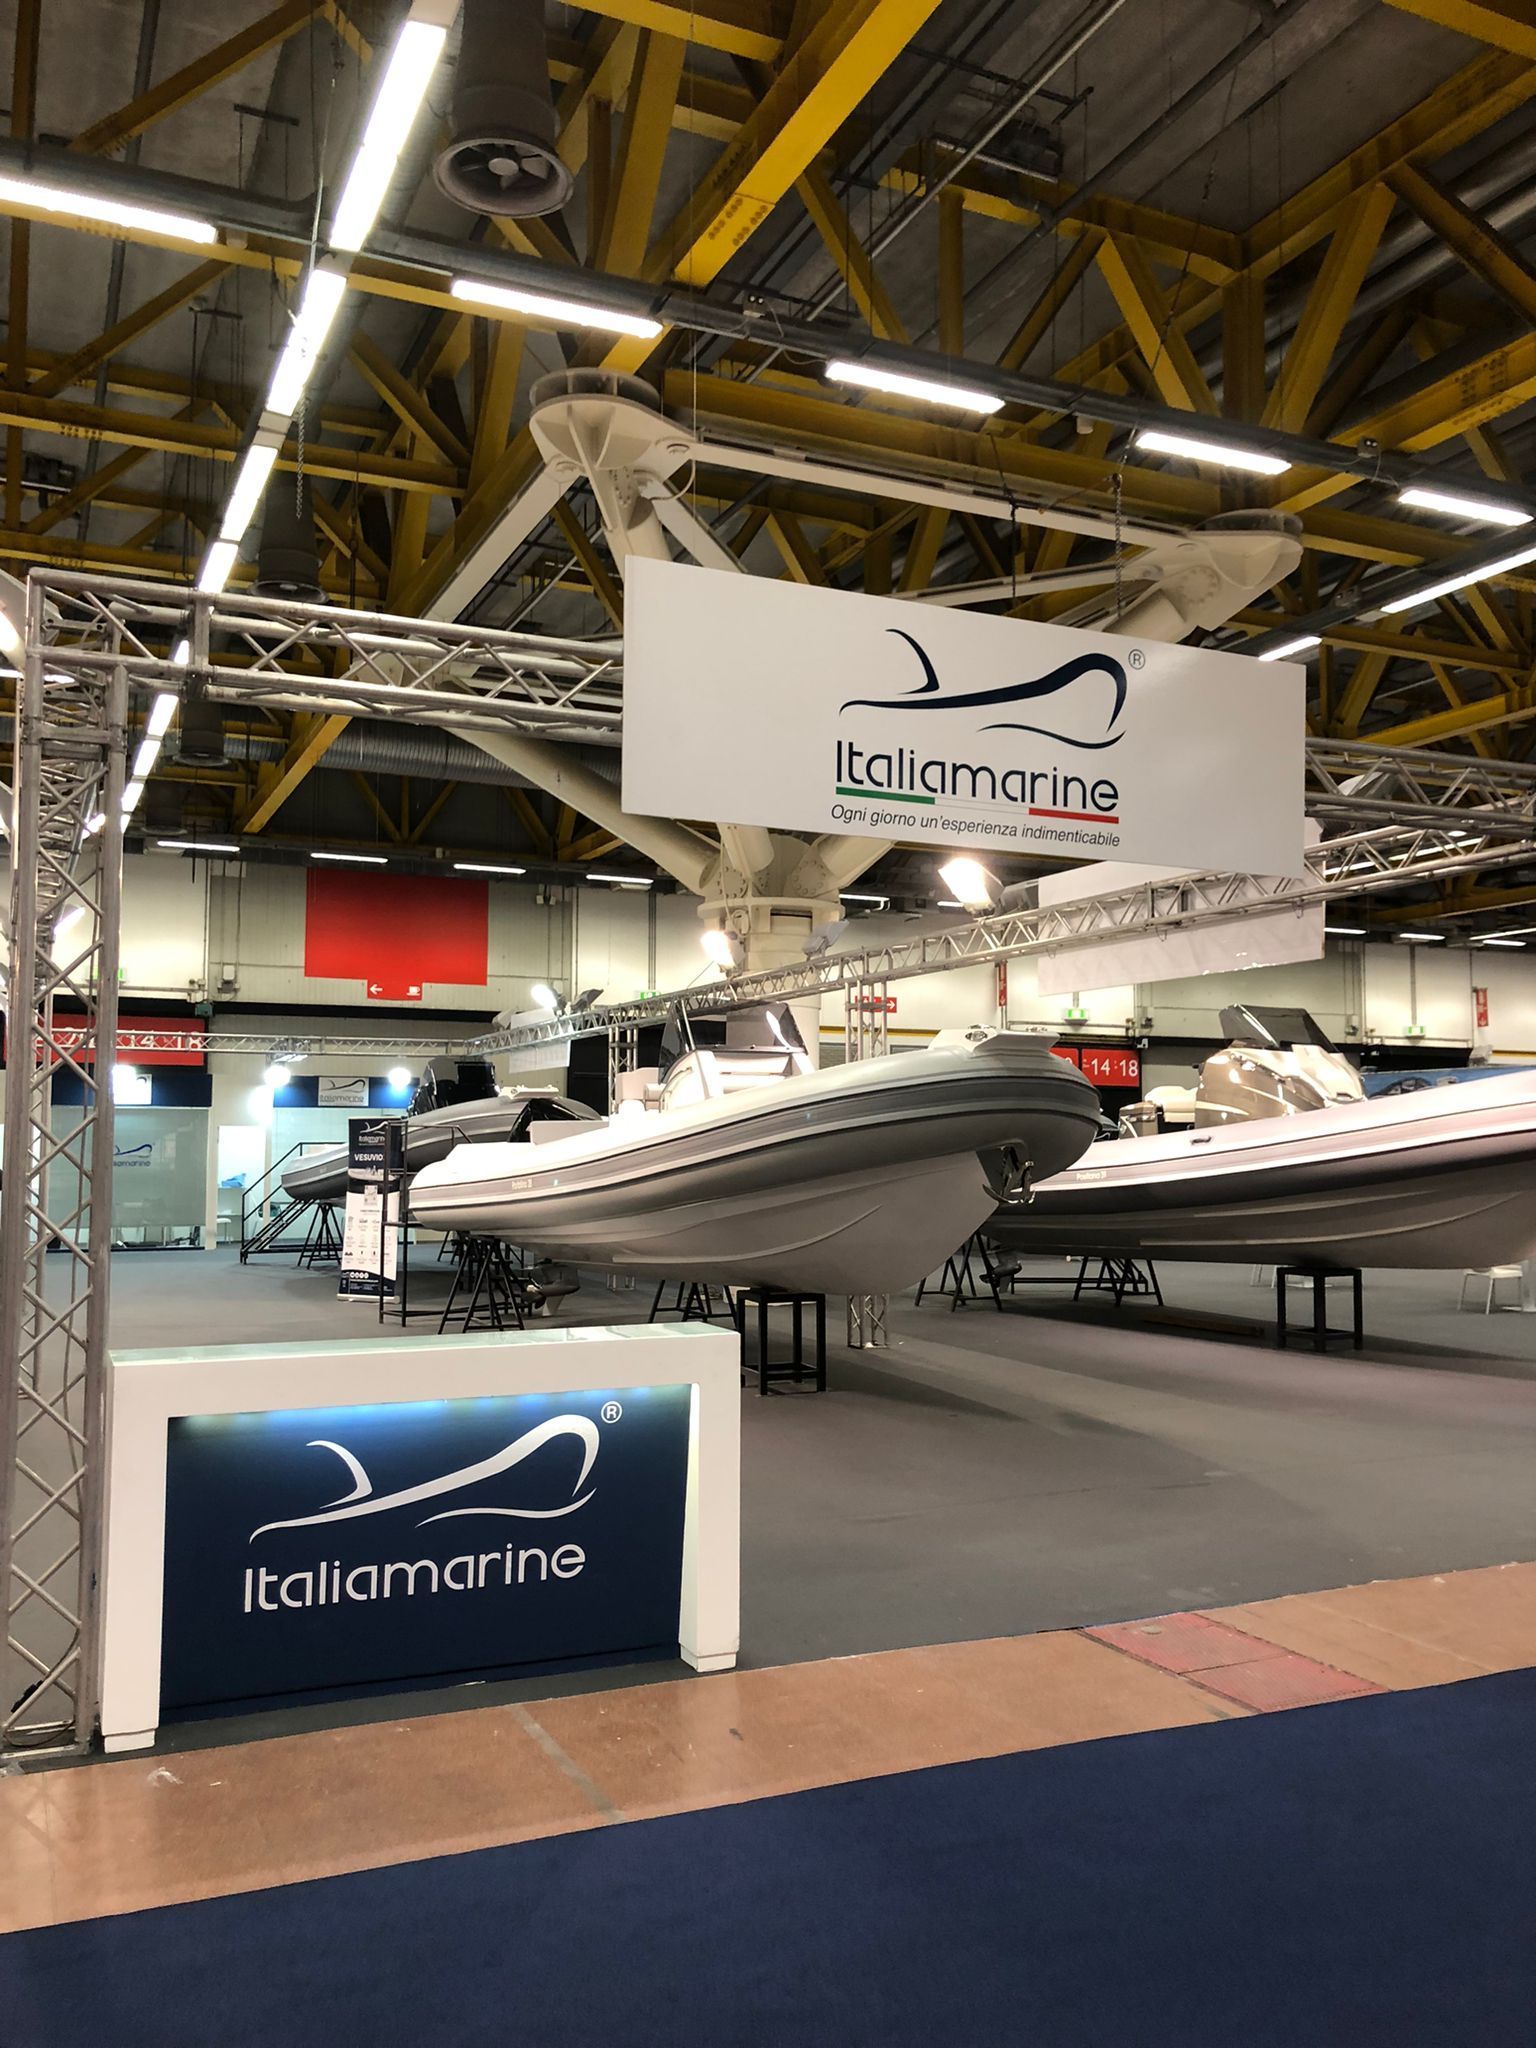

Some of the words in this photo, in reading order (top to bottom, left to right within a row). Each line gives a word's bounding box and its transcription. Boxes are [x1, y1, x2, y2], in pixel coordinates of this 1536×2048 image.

[836, 740, 1119, 812] Italiamarine
[831, 804, 867, 824] Ogni
[871, 808, 916, 828] giorno
[920, 814, 1018, 838] un'esperienza
[1021, 824, 1121, 847] indimenticabile
[354, 1153, 384, 1161] VESUVIO
[243, 1543, 586, 1613] Italiamarine
